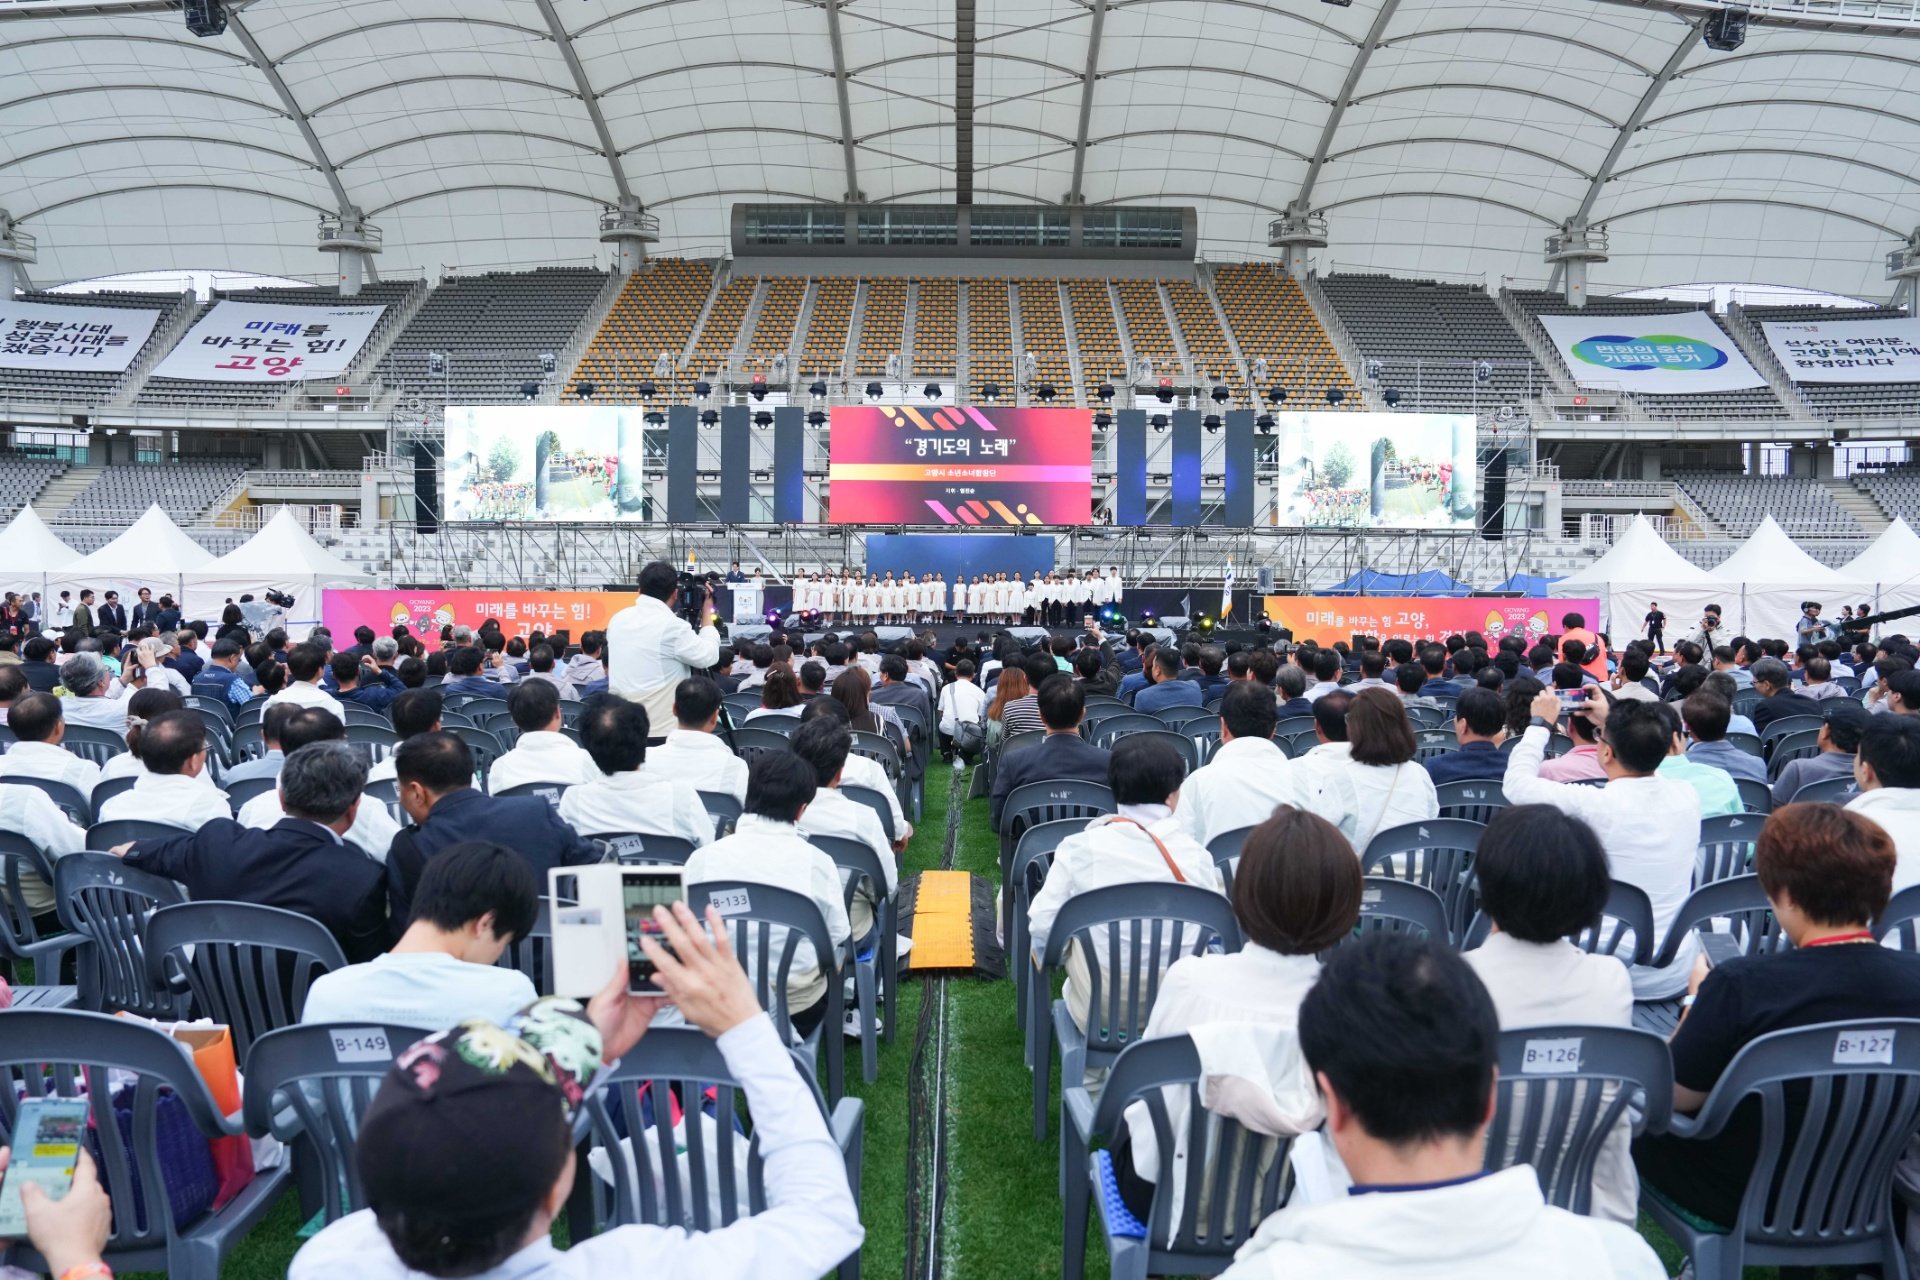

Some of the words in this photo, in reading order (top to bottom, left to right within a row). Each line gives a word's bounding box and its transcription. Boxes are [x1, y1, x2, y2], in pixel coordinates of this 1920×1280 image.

[15, 319, 113, 334] 행복시대
[244, 321, 331, 337] 미래를
[5, 331, 129, 346] 성공시대를
[201, 336, 294, 352] 바꾸는
[306, 339, 346, 353] 힘!
[1784, 339, 1839, 347] 선수단
[1595, 345, 1653, 354] 변화의
[1656, 344, 1695, 353] 중심
[214, 355, 304, 376] 고양
[1600, 354, 1660, 363] 기회의
[1662, 354, 1702, 363] 경기
[1795, 358, 1895, 368] 환영합니다
[925, 469, 946, 477] 고양시
[947, 469, 996, 477] 소년소녀합창단
[413, 605, 431, 613] 2023
[475, 602, 518, 619] 미래를
[523, 603, 566, 620] 바꾸는
[570, 603, 591, 620] 힘!
[1306, 611, 1344, 627] 미래를
[1348, 615, 1378, 628] 바꾸는
[1381, 615, 1392, 628] 힘
[1395, 611, 1429, 629] 고양,
[713, 895, 747, 908] B-133
[335, 1036, 386, 1051] B-149
[1838, 1038, 1890, 1053] B-127
[1526, 1048, 1577, 1063] B-126
